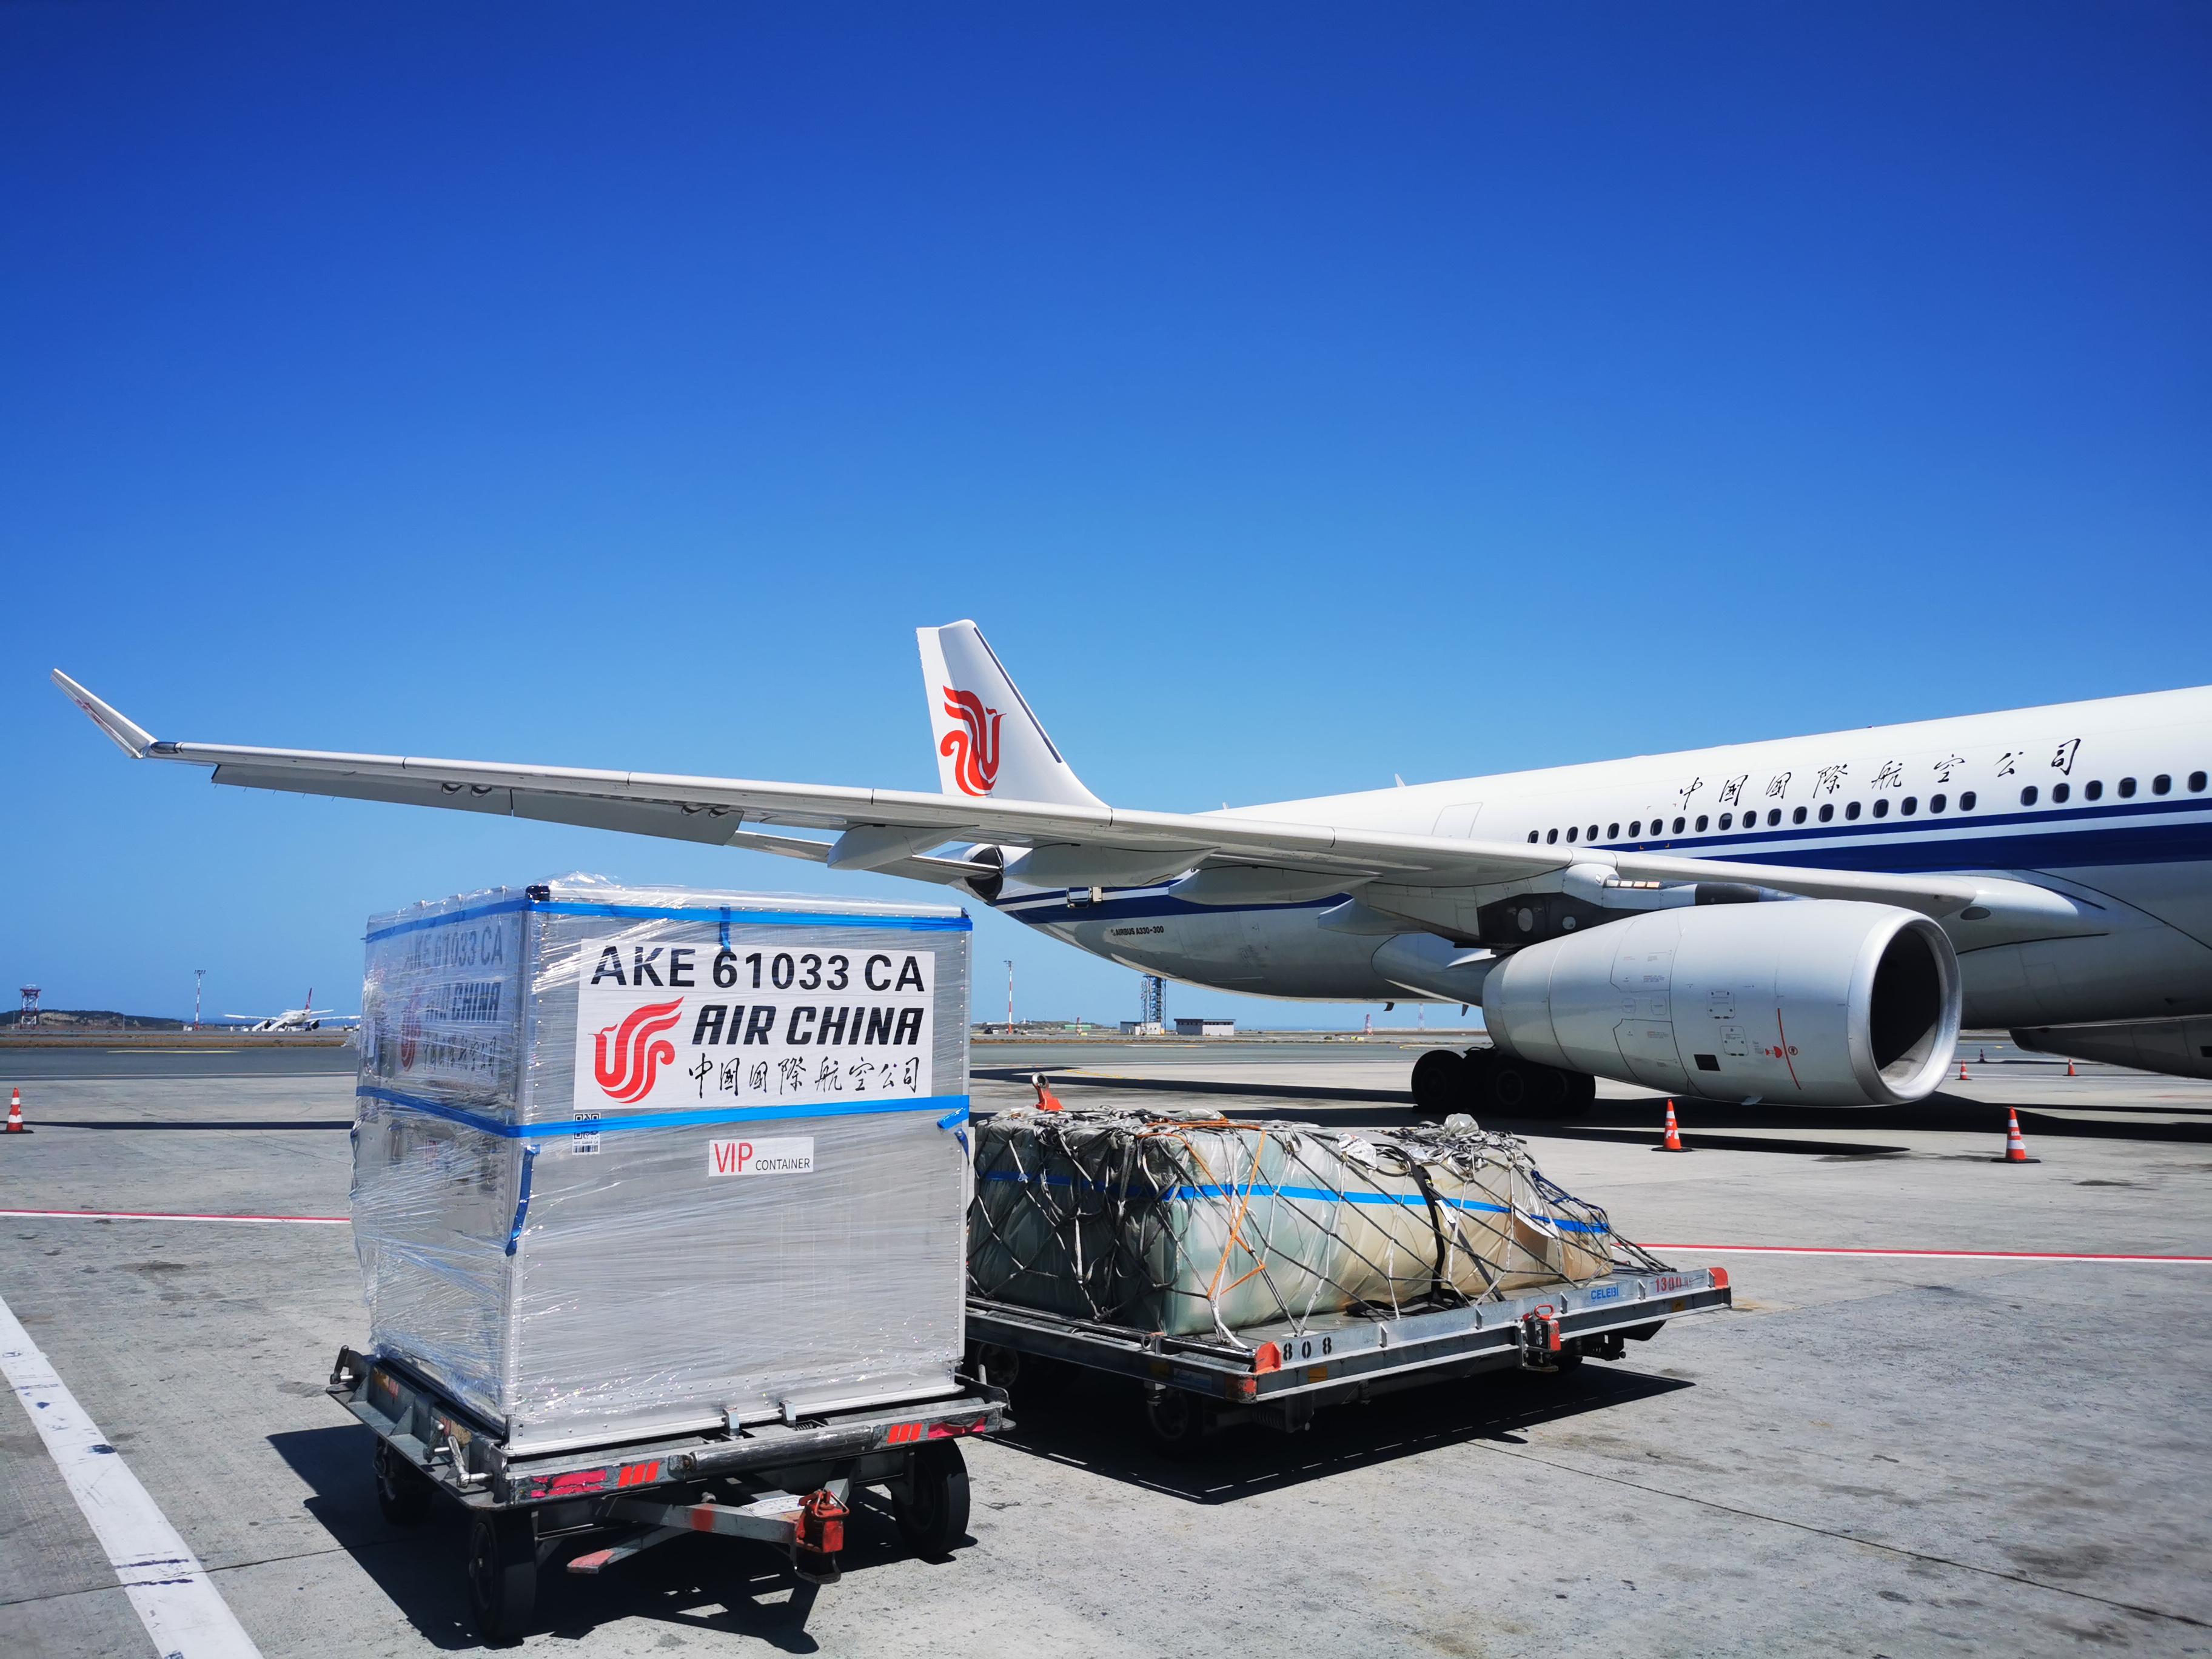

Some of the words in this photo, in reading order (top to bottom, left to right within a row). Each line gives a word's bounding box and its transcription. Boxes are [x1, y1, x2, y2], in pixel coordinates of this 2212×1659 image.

[481, 925, 503, 965] CA
[1116, 928, 1135, 936] AIRBUS
[1136, 925, 1164, 935] A330-300
[591, 945, 695, 987] AKE
[712, 951, 850, 991] 61033
[865, 954, 925, 992] CA
[452, 982, 501, 1024] CHINA
[692, 1004, 777, 1045] AIR
[786, 1006, 925, 1045] CHINA
[714, 1142, 752, 1174] VIP
[756, 1158, 811, 1171] CONTAINER
[1283, 1336, 1332, 1361] 808
